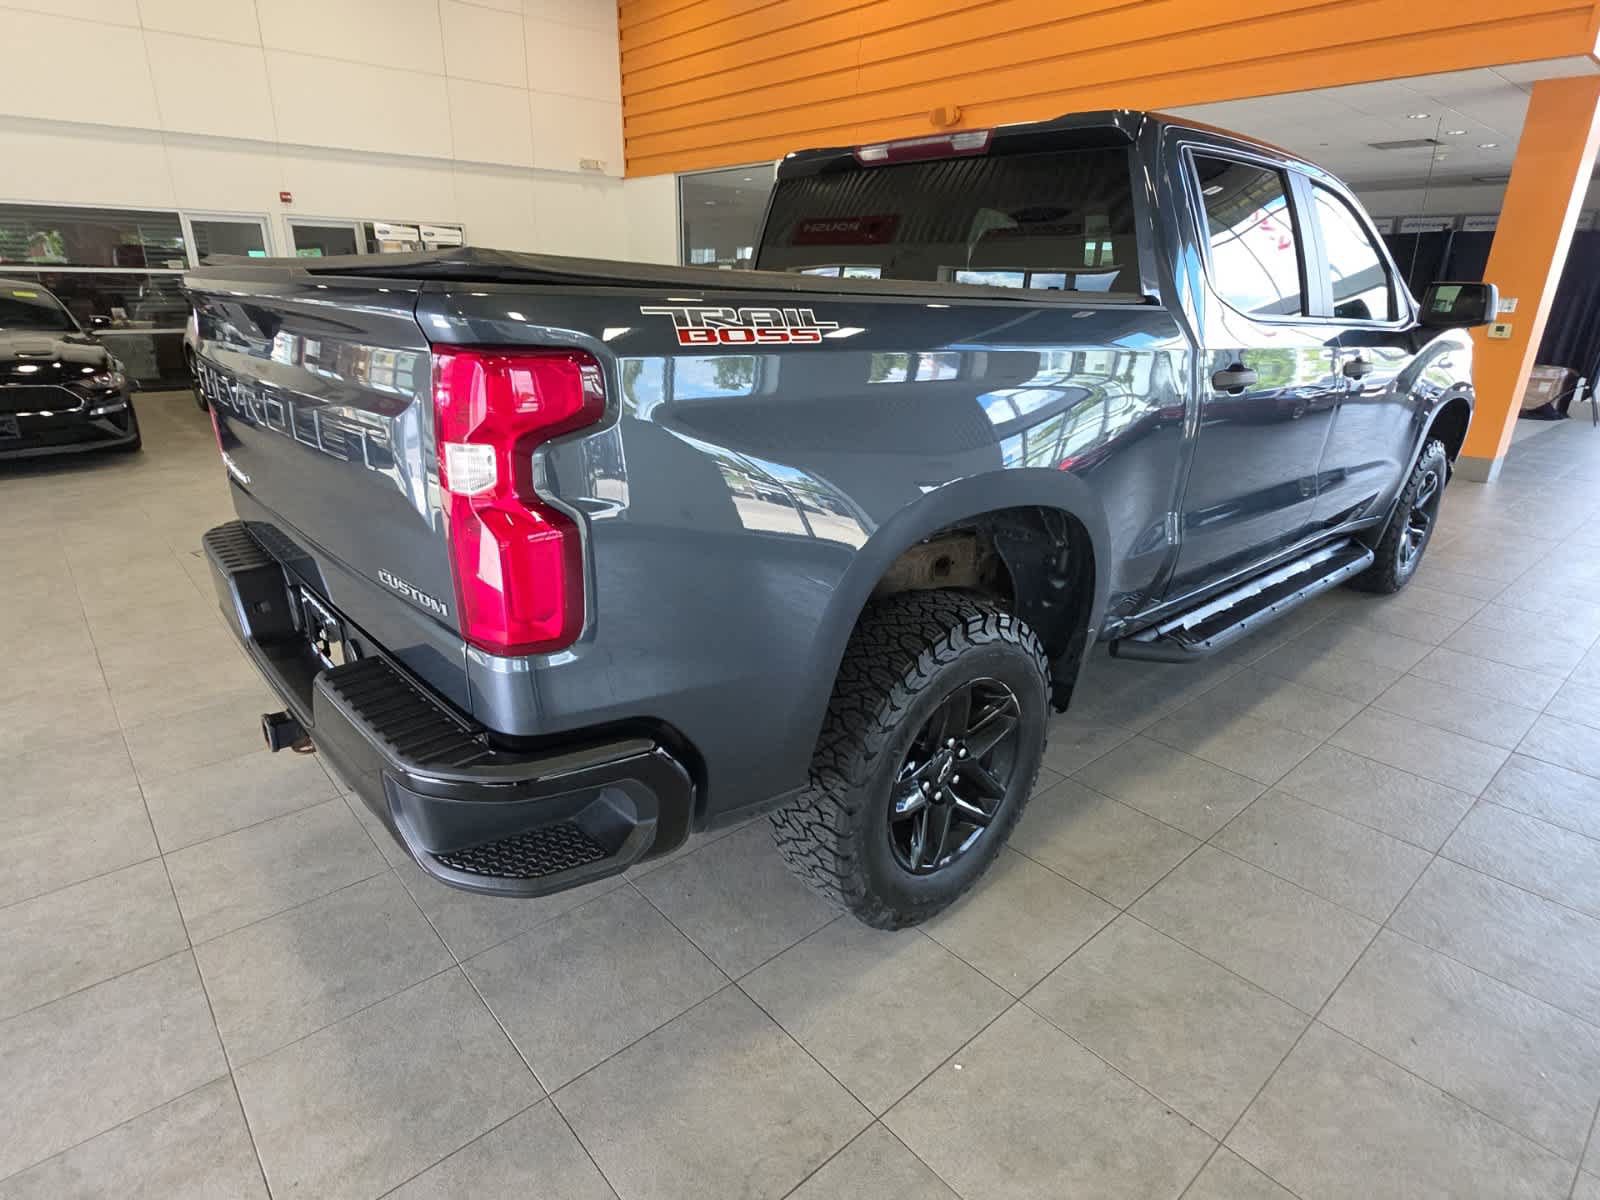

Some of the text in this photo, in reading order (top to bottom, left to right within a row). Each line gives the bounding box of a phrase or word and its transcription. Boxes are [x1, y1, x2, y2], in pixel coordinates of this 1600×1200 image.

[640, 306, 839, 329] TRAIL
[675, 327, 823, 346] BOSS
[377, 568, 449, 617] CUSTOM
